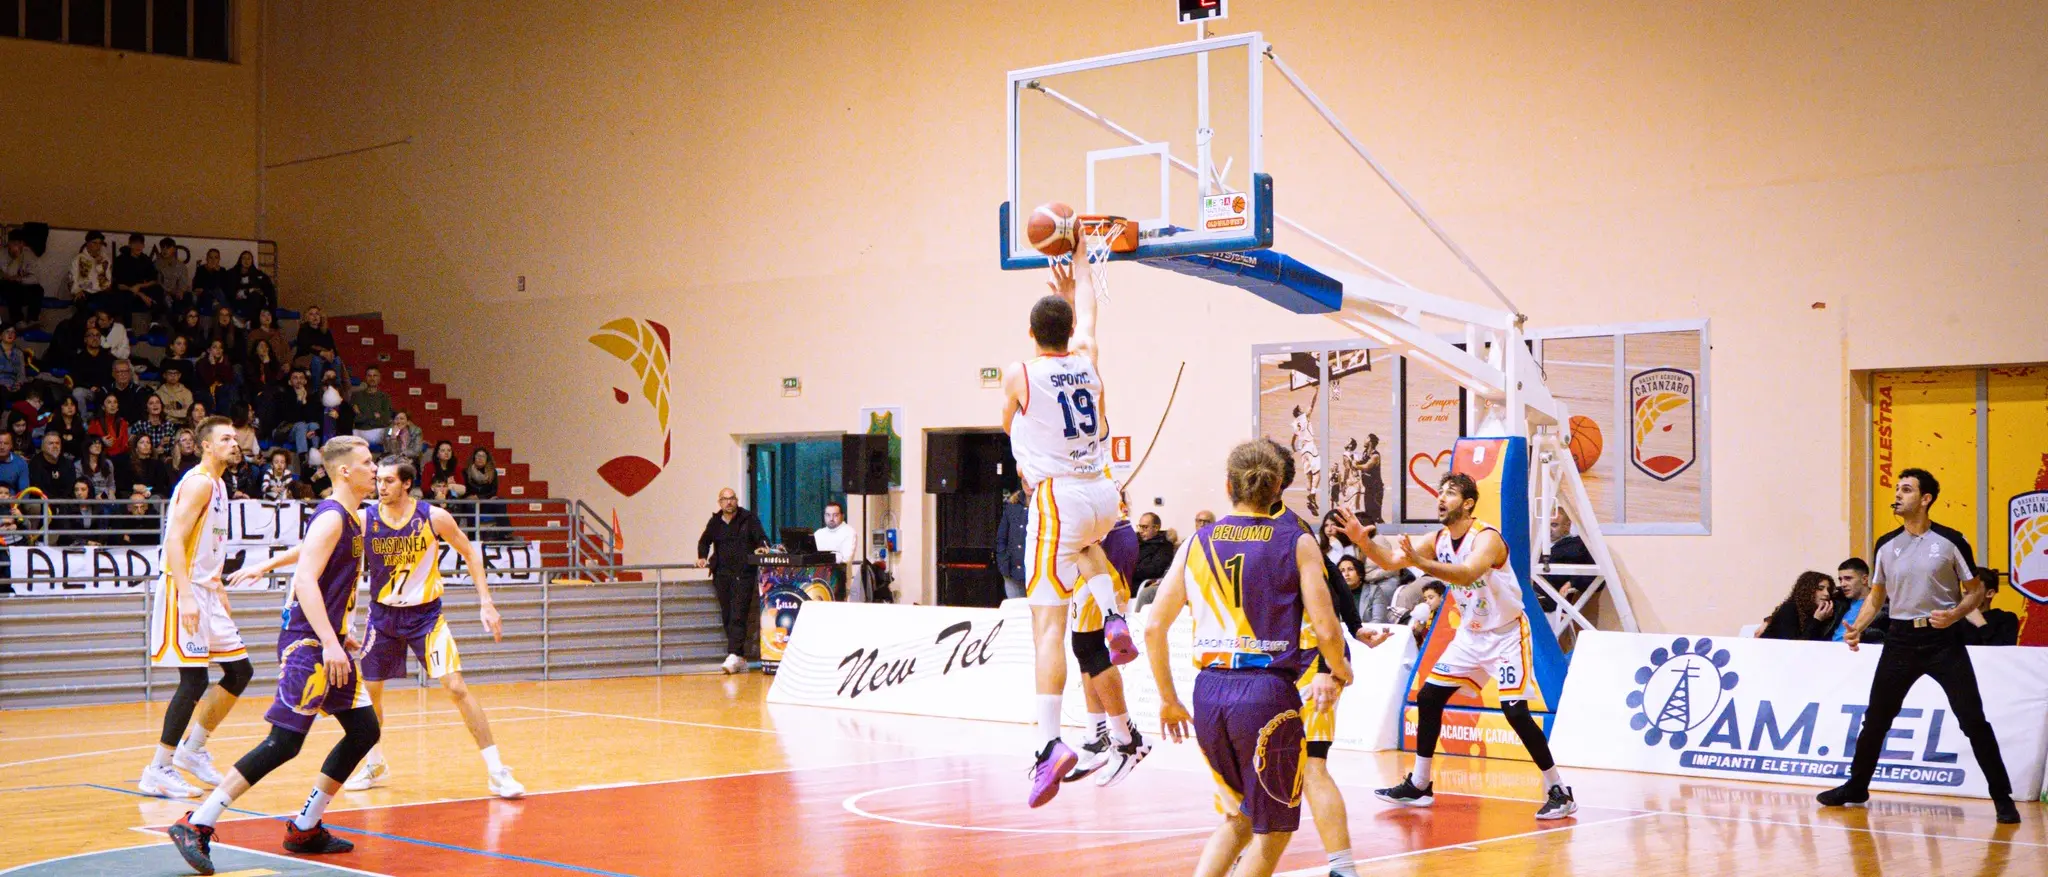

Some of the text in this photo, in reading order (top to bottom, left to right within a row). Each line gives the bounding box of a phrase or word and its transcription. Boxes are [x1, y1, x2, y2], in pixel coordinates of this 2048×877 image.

[1634, 380, 1690, 397] CATANZARO
[1420, 393, 1460, 412] Sempre
[1057, 388, 1098, 440] 19
[1418, 413, 1450, 423] con noi
[1879, 385, 1893, 489] PALESTRA
[2012, 502, 2048, 518] CATAN
[1211, 524, 1274, 542] BELLOMO
[371, 535, 428, 555] CASTANEA
[383, 553, 416, 567] MESSINA
[389, 569, 411, 596] 17
[1225, 553, 1246, 608] 1
[430, 650, 440, 668] 17
[836, 618, 1005, 699] New Tel
[1498, 665, 1516, 685] 36
[1440, 724, 1484, 742] ACADEMY
[1699, 697, 1959, 764] AM.TEL
[1692, 753, 1756, 770] IMPIANTI
[1761, 759, 1839, 776] ELETTRICI
[1872, 767, 1954, 783] ELEFONICI
